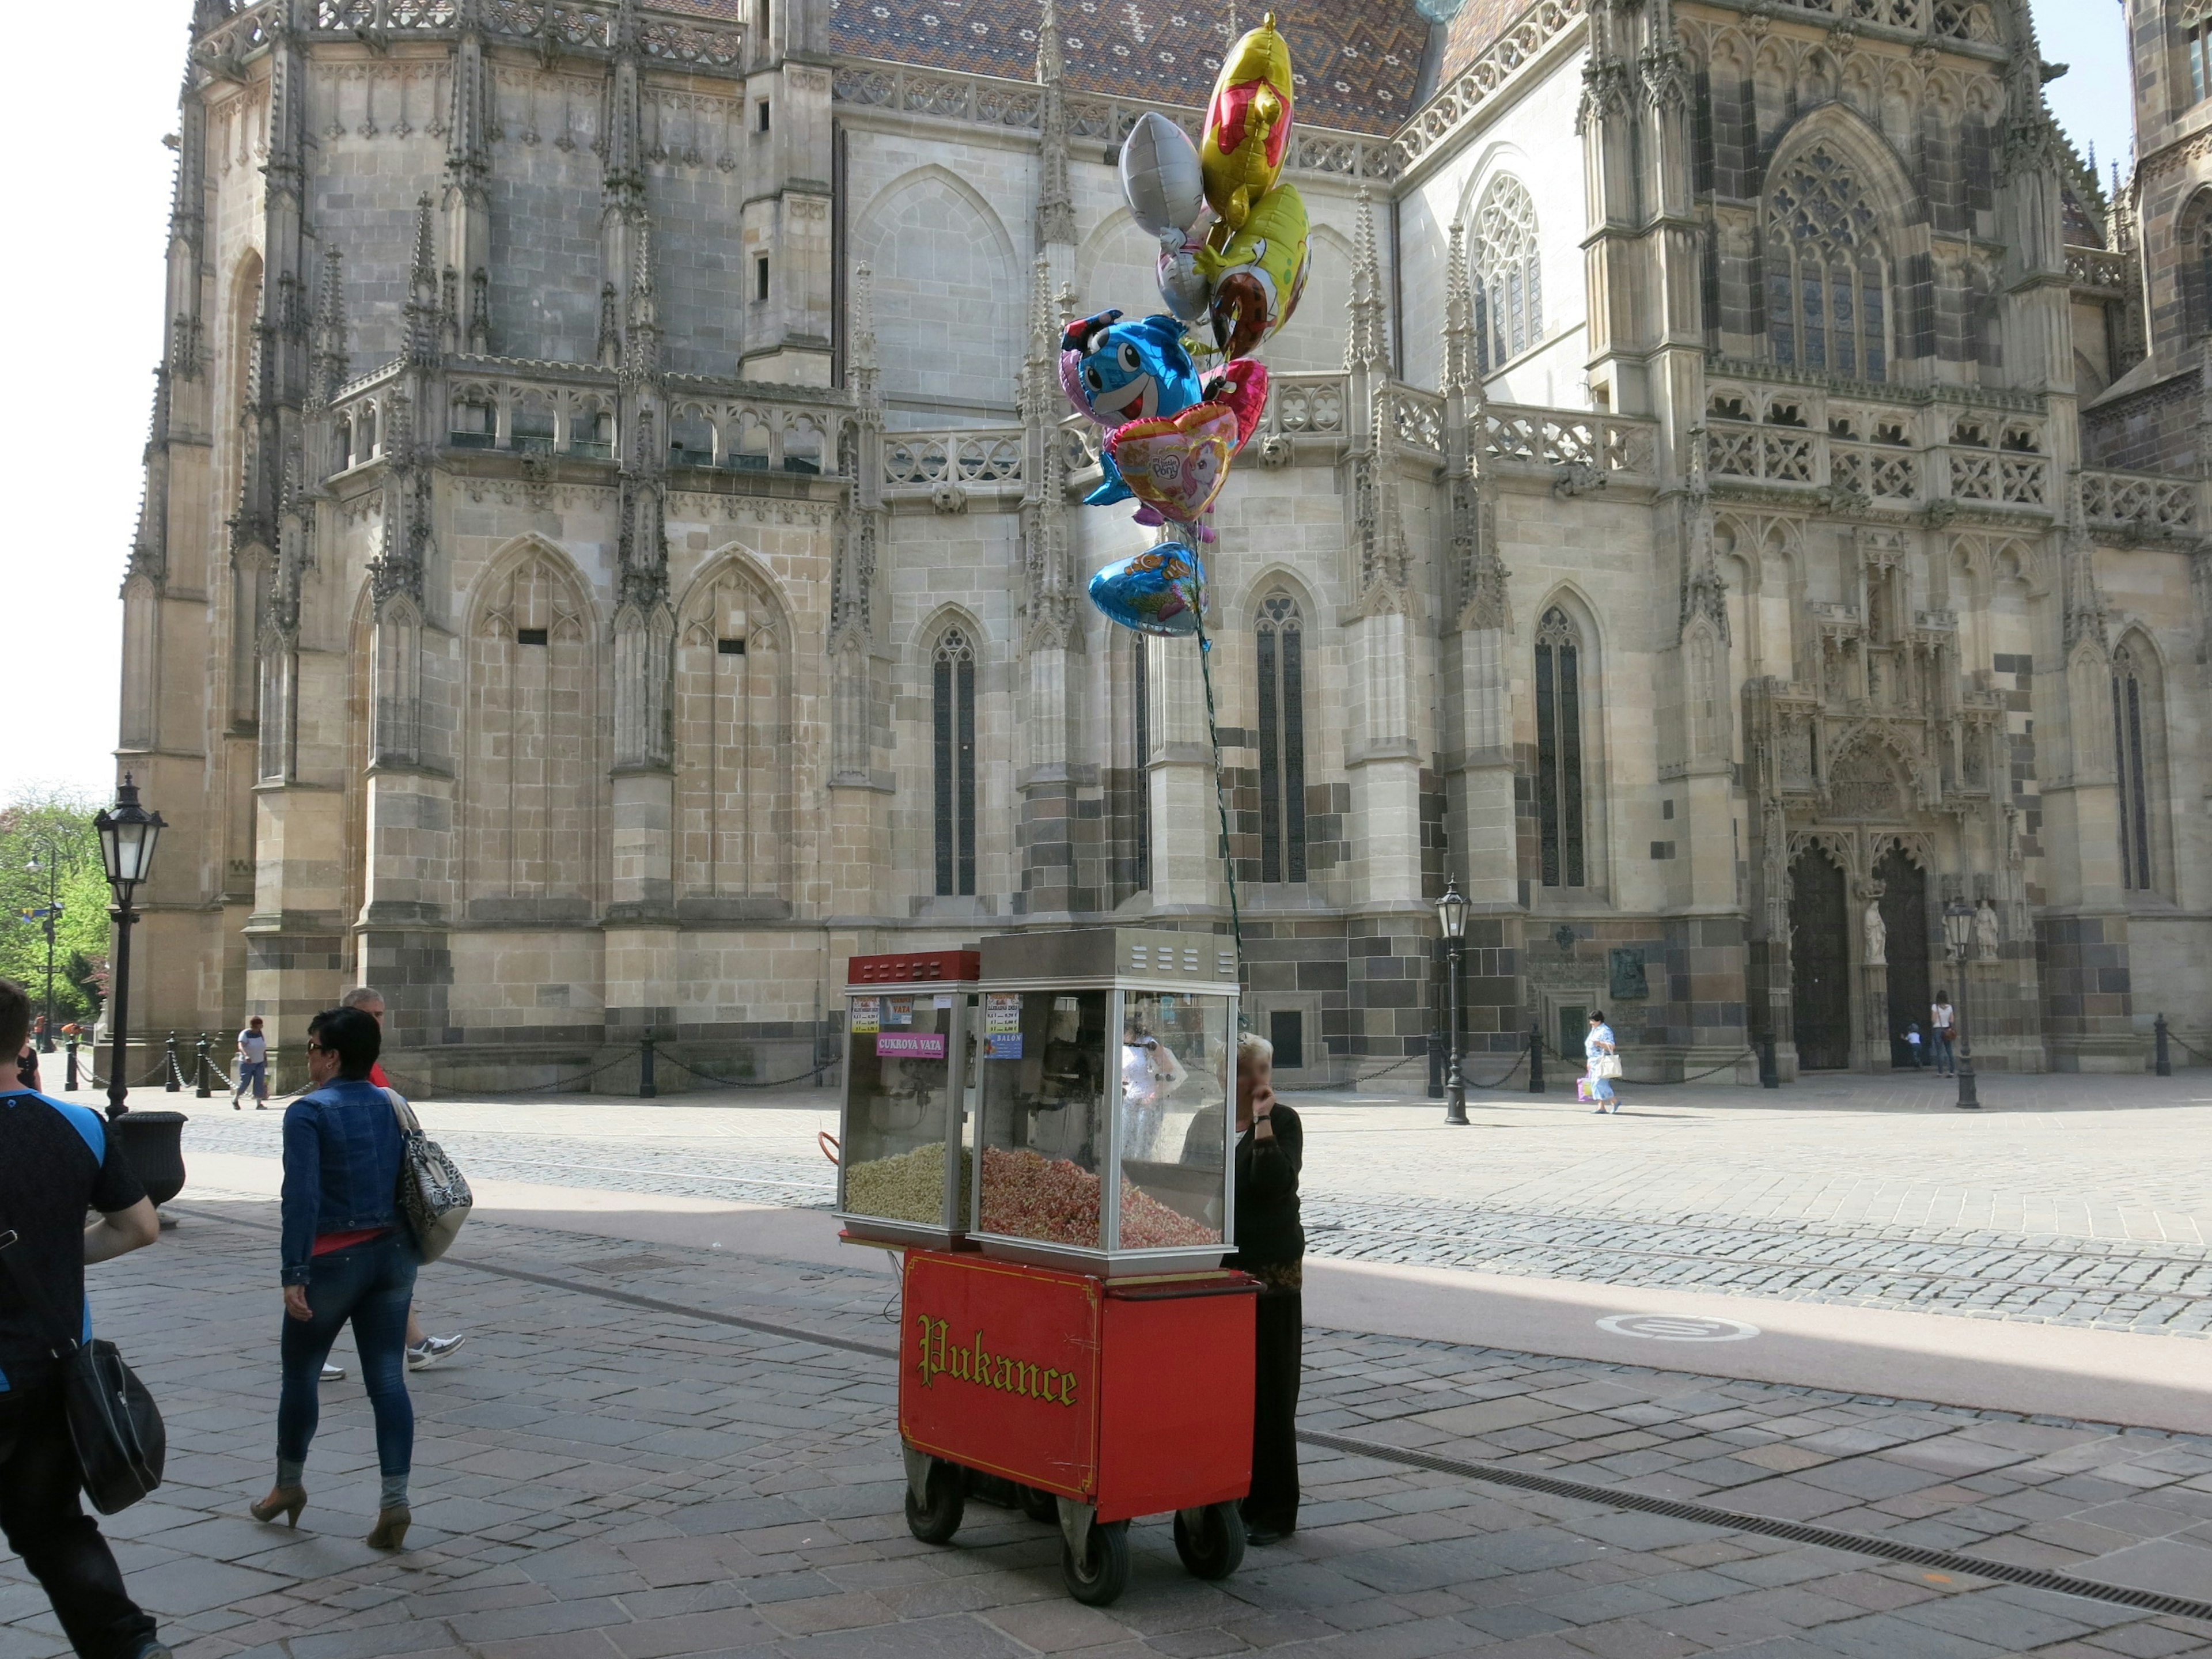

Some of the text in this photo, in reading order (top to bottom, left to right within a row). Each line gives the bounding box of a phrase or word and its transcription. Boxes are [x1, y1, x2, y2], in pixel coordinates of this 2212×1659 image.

[1153, 464, 1179, 479] Pony
[879, 1037, 942, 1051] CUKROVÁ VATA
[916, 1313, 1078, 1407] Pukance
